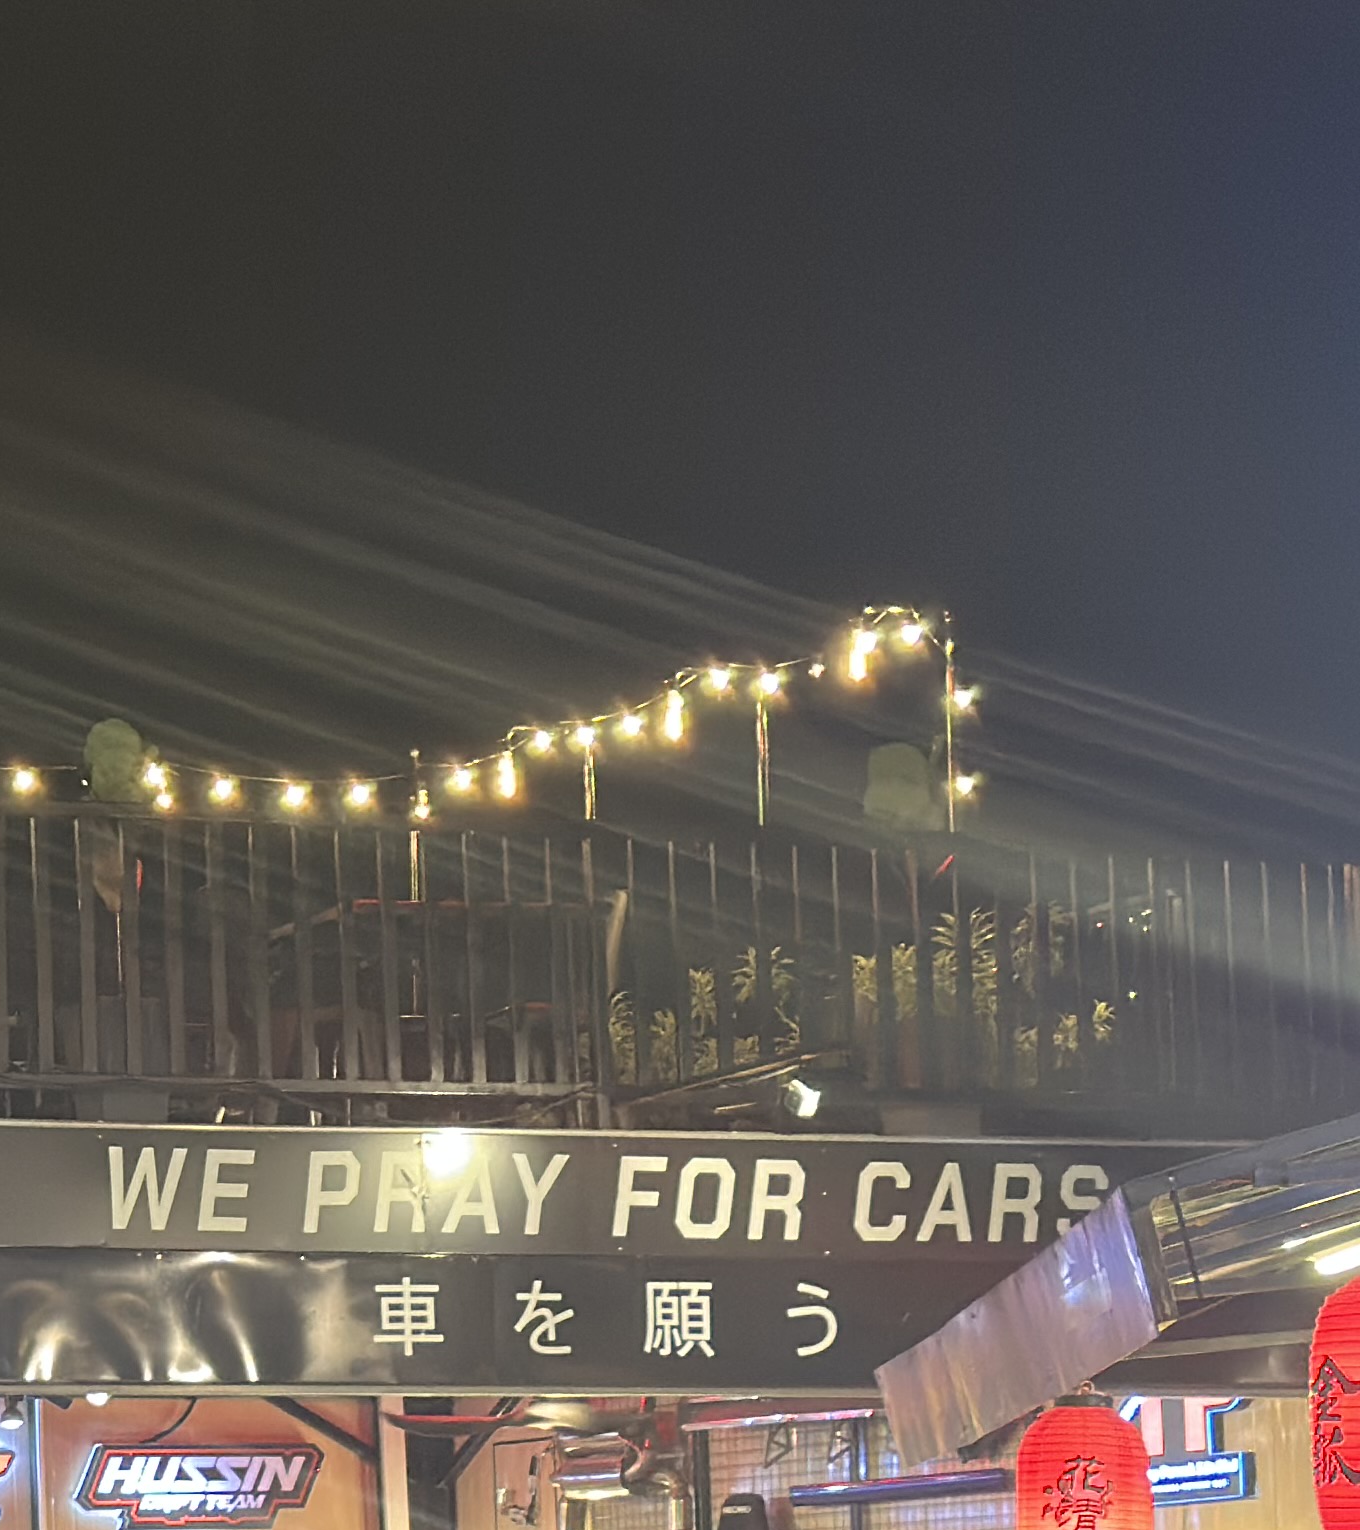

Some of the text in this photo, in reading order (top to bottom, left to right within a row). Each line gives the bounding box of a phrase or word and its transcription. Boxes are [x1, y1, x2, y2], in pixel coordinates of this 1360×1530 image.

[108, 1146, 1109, 1244] WE PRAY FOR CARS
[373, 1276, 838, 1358] 車を願う
[97, 1456, 306, 1494] HUSSIN
